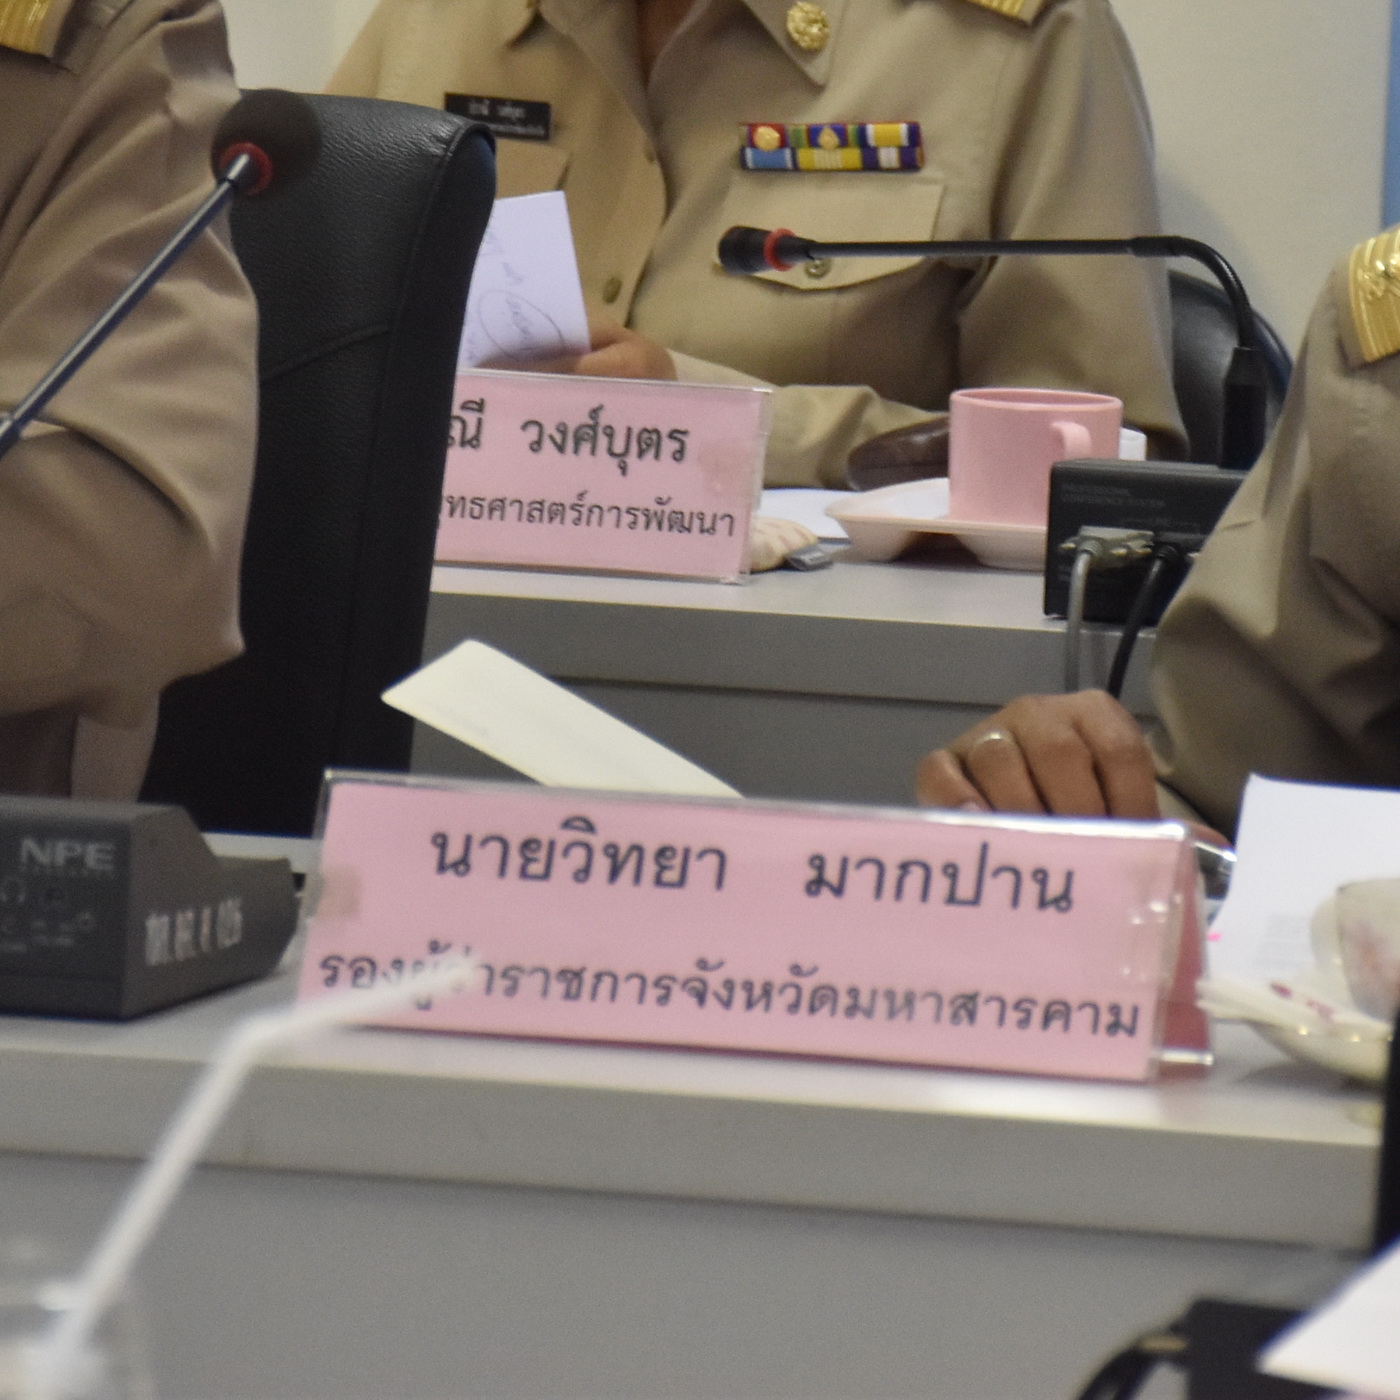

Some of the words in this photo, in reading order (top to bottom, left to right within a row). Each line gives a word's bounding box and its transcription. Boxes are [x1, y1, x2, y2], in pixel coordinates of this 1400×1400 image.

[520, 403, 691, 476] วงศ์บุตร
[20, 836, 116, 871] NPE
[430, 816, 729, 892] นายวิทยา
[803, 840, 1076, 915] มากปาน
[319, 939, 1141, 1038] รองู้่าราชการจังหวัดมหาสารคาม
